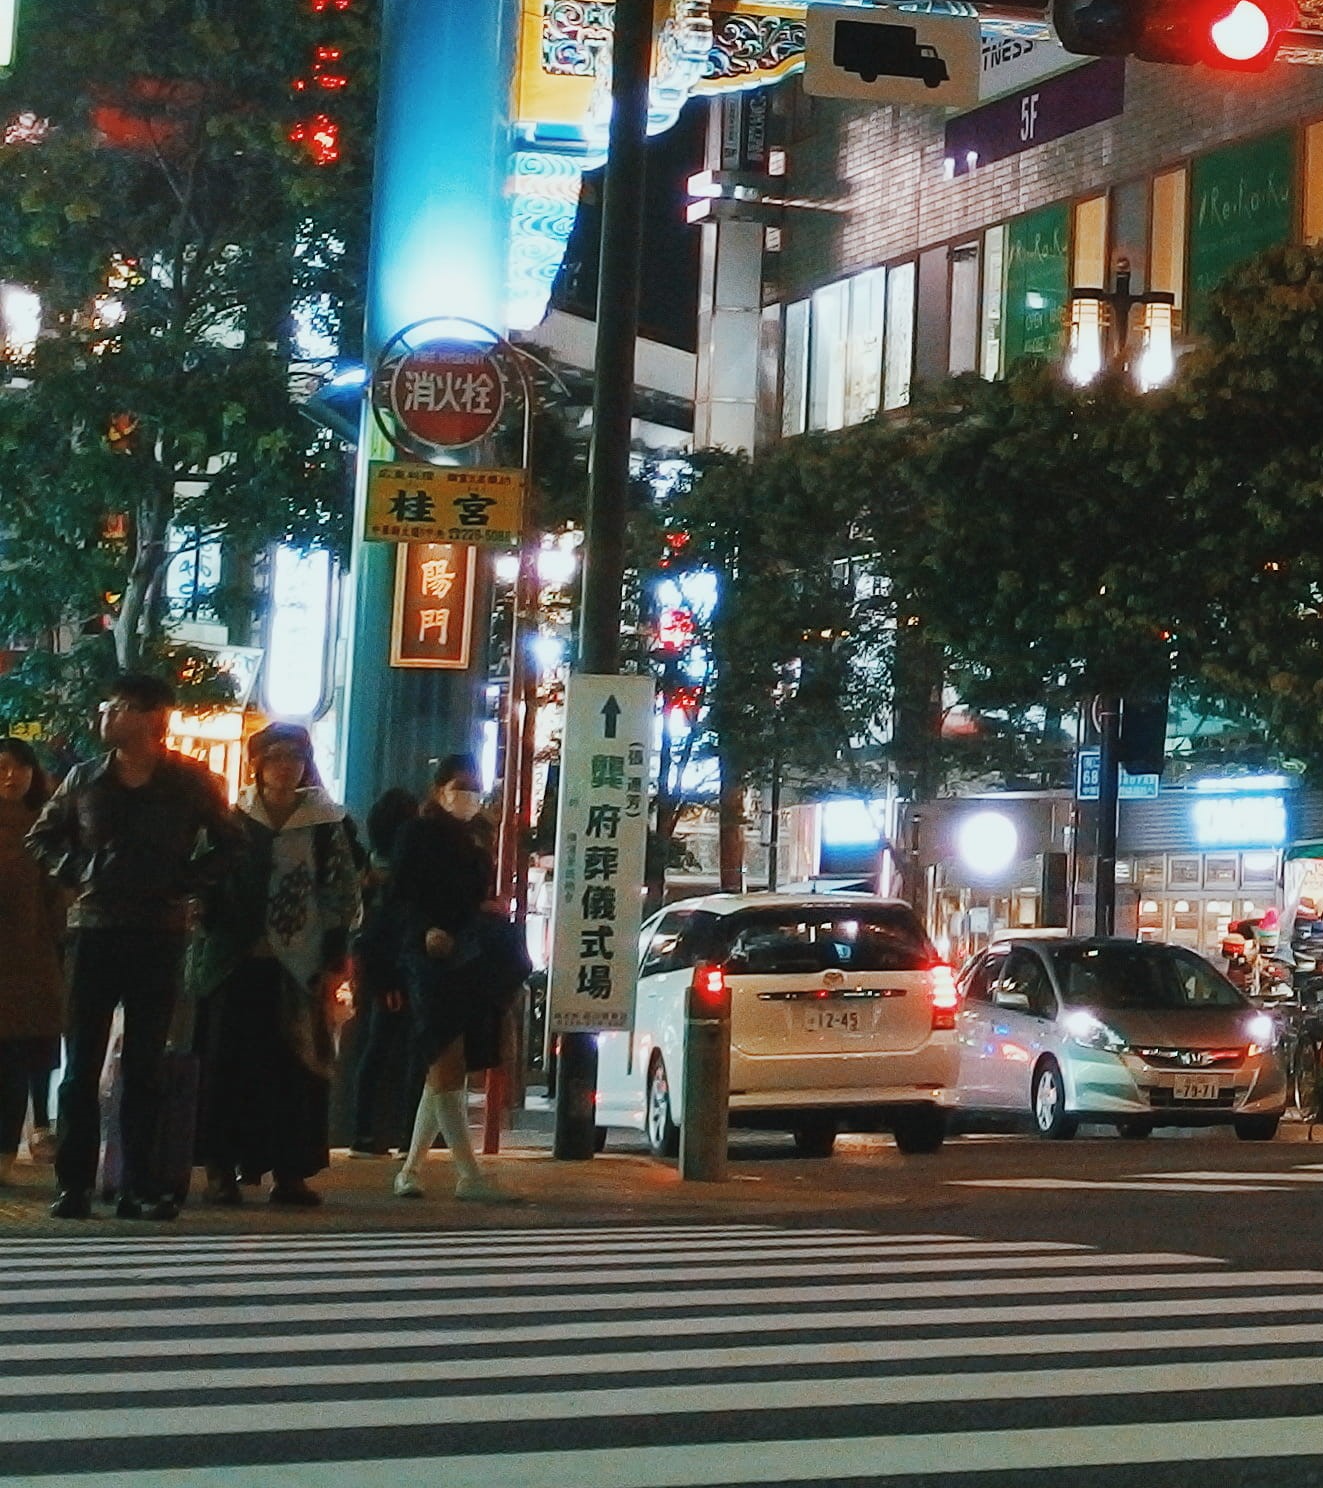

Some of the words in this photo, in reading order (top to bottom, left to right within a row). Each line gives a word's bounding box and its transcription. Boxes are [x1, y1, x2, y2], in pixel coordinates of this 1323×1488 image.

[1021, 93, 1040, 142] 5F
[404, 371, 494, 414] 消火栓
[389, 489, 498, 526] 桂宮
[419, 543, 457, 645] 陽門
